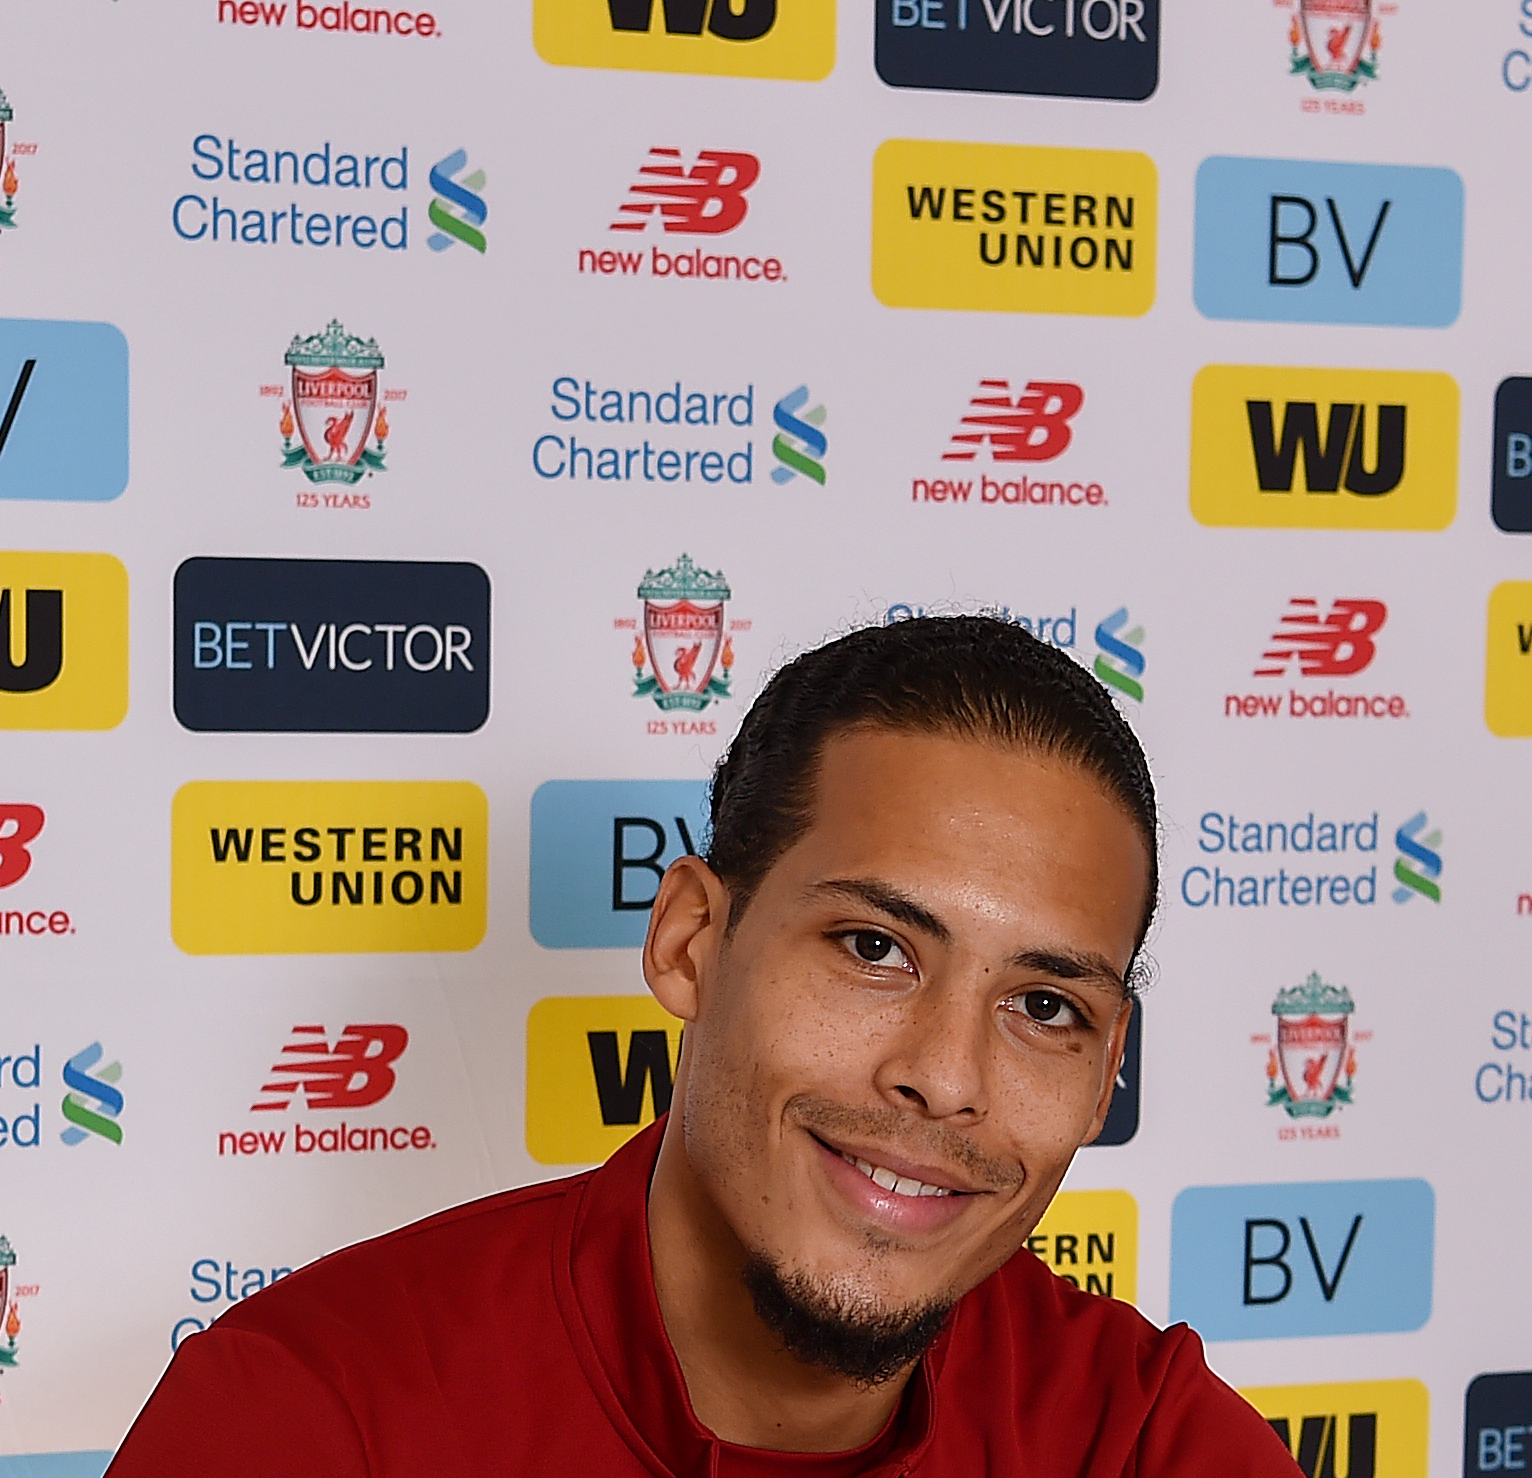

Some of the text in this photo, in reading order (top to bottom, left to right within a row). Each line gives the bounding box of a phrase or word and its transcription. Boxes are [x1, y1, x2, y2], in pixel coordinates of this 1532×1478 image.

[216, 0, 285, 26] new
[193, 134, 408, 190] Standard
[173, 194, 408, 250] Chartered
[907, 186, 1133, 228] WESTERN
[579, 249, 643, 274] new
[980, 233, 1132, 270] UNION
[1269, 195, 1390, 288] BV
[552, 376, 753, 426] Standard
[533, 435, 752, 484] Chartered
[1246, 400, 1406, 496] WU
[913, 479, 972, 502] new
[195, 623, 473, 671] BETVICTOR
[1224, 694, 1282, 718] new
[211, 828, 462, 862] WESTERN
[1199, 812, 1378, 853] Standard
[292, 870, 461, 906] UNION
[1181, 866, 1376, 907] Chartered
[219, 1131, 286, 1155] new
[1243, 1215, 1362, 1305] BV
